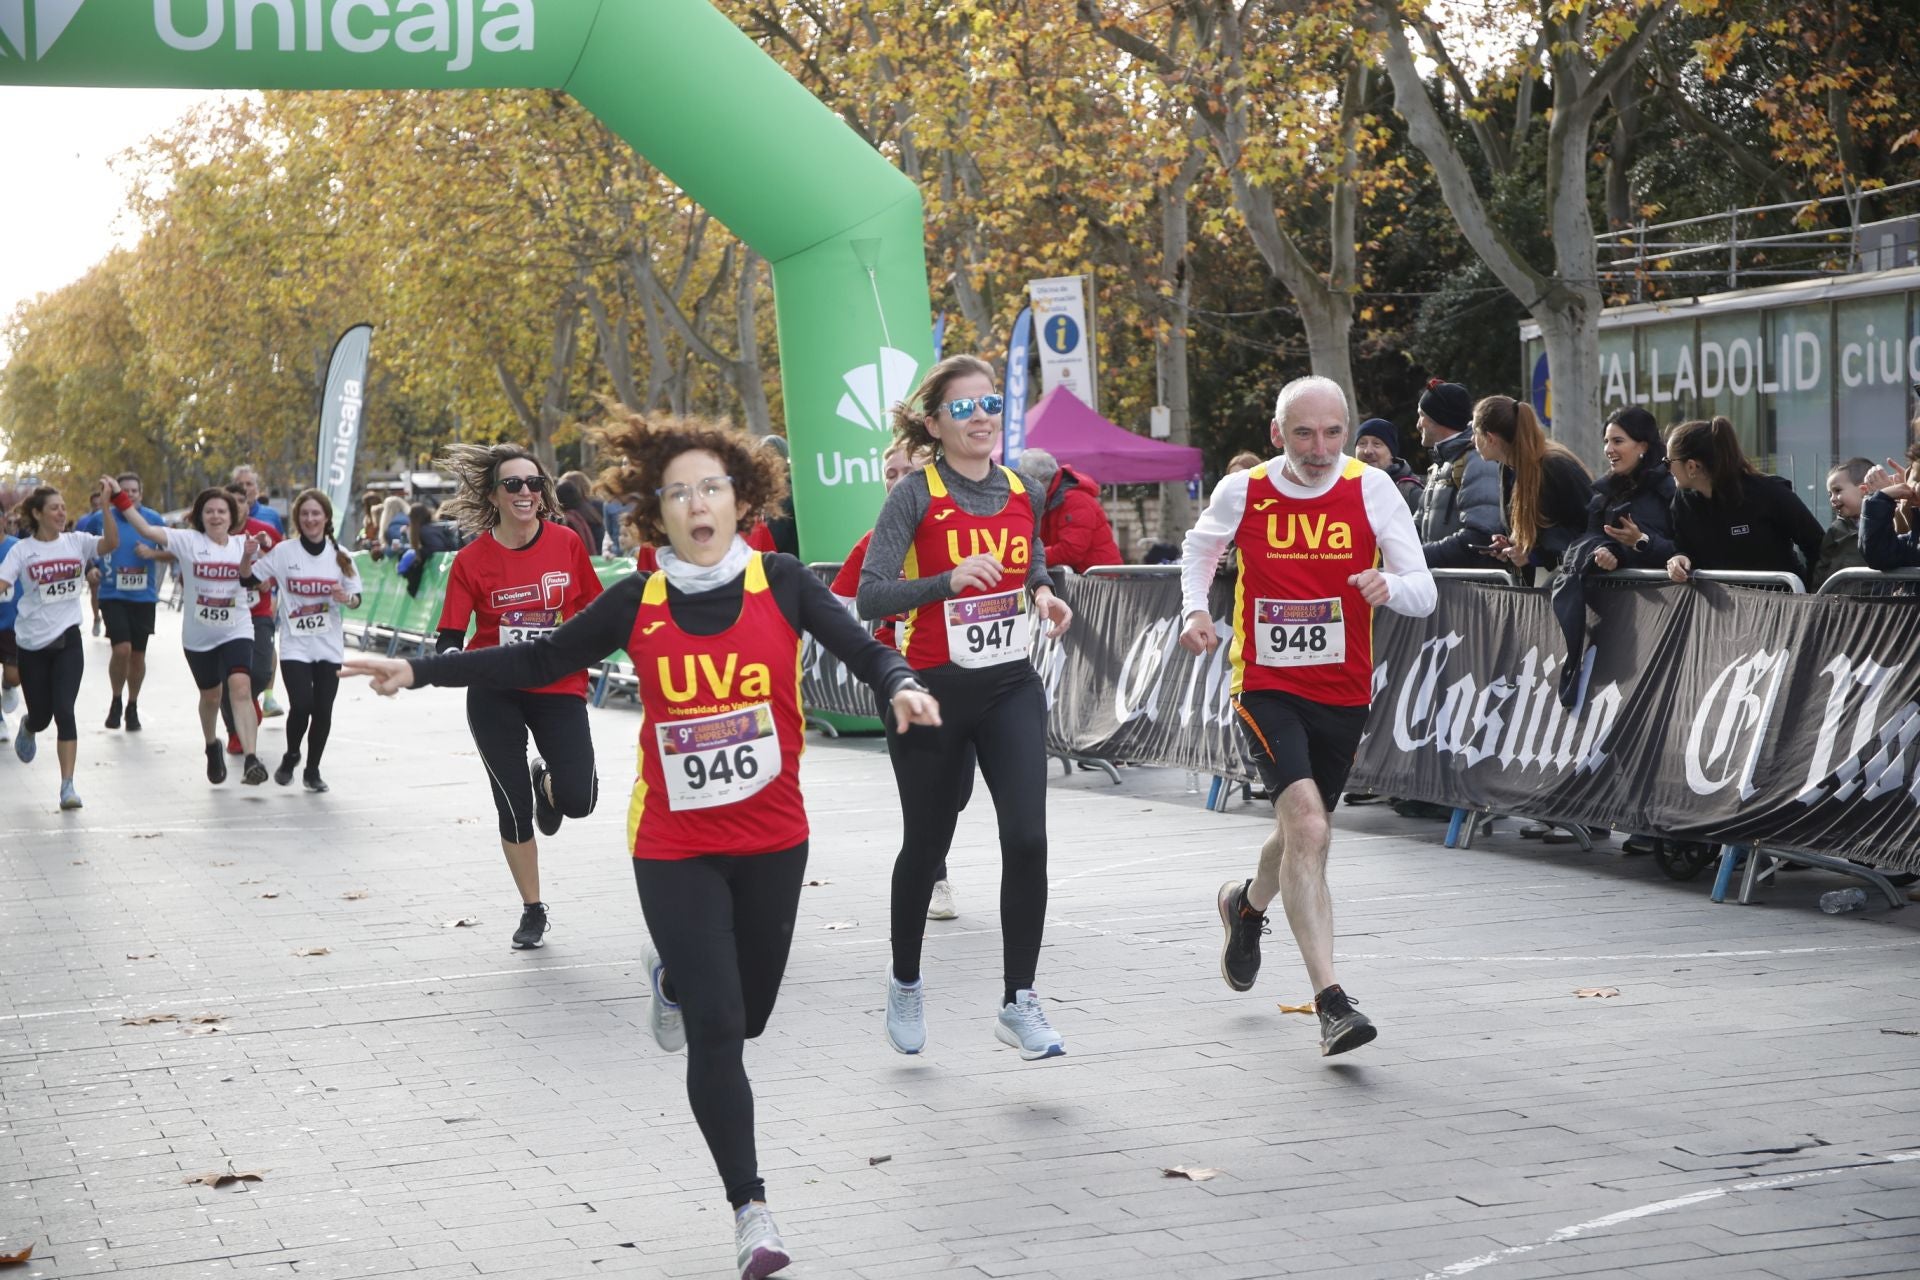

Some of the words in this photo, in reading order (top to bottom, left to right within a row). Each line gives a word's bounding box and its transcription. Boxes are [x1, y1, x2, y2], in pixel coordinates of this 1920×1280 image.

[153, 0, 535, 71] Unicaja
[1600, 331, 1822, 406] ALLADOLID
[329, 379, 363, 486] Unicaja
[946, 528, 1029, 566] UVa
[1267, 513, 1352, 549] UVa
[1266, 551, 1308, 560] Universidad
[1320, 552, 1353, 560] Valladolid
[46, 580, 76, 597] 455
[200, 607, 229, 621] 459
[296, 615, 325, 630] 462
[966, 618, 1015, 653] 947
[1270, 625, 1327, 653] 948
[656, 653, 772, 703] UVa
[668, 703, 718, 715] Universidad
[719, 703, 731, 712] de
[694, 726, 738, 743] EMPRESAS
[683, 744, 759, 790] 946
